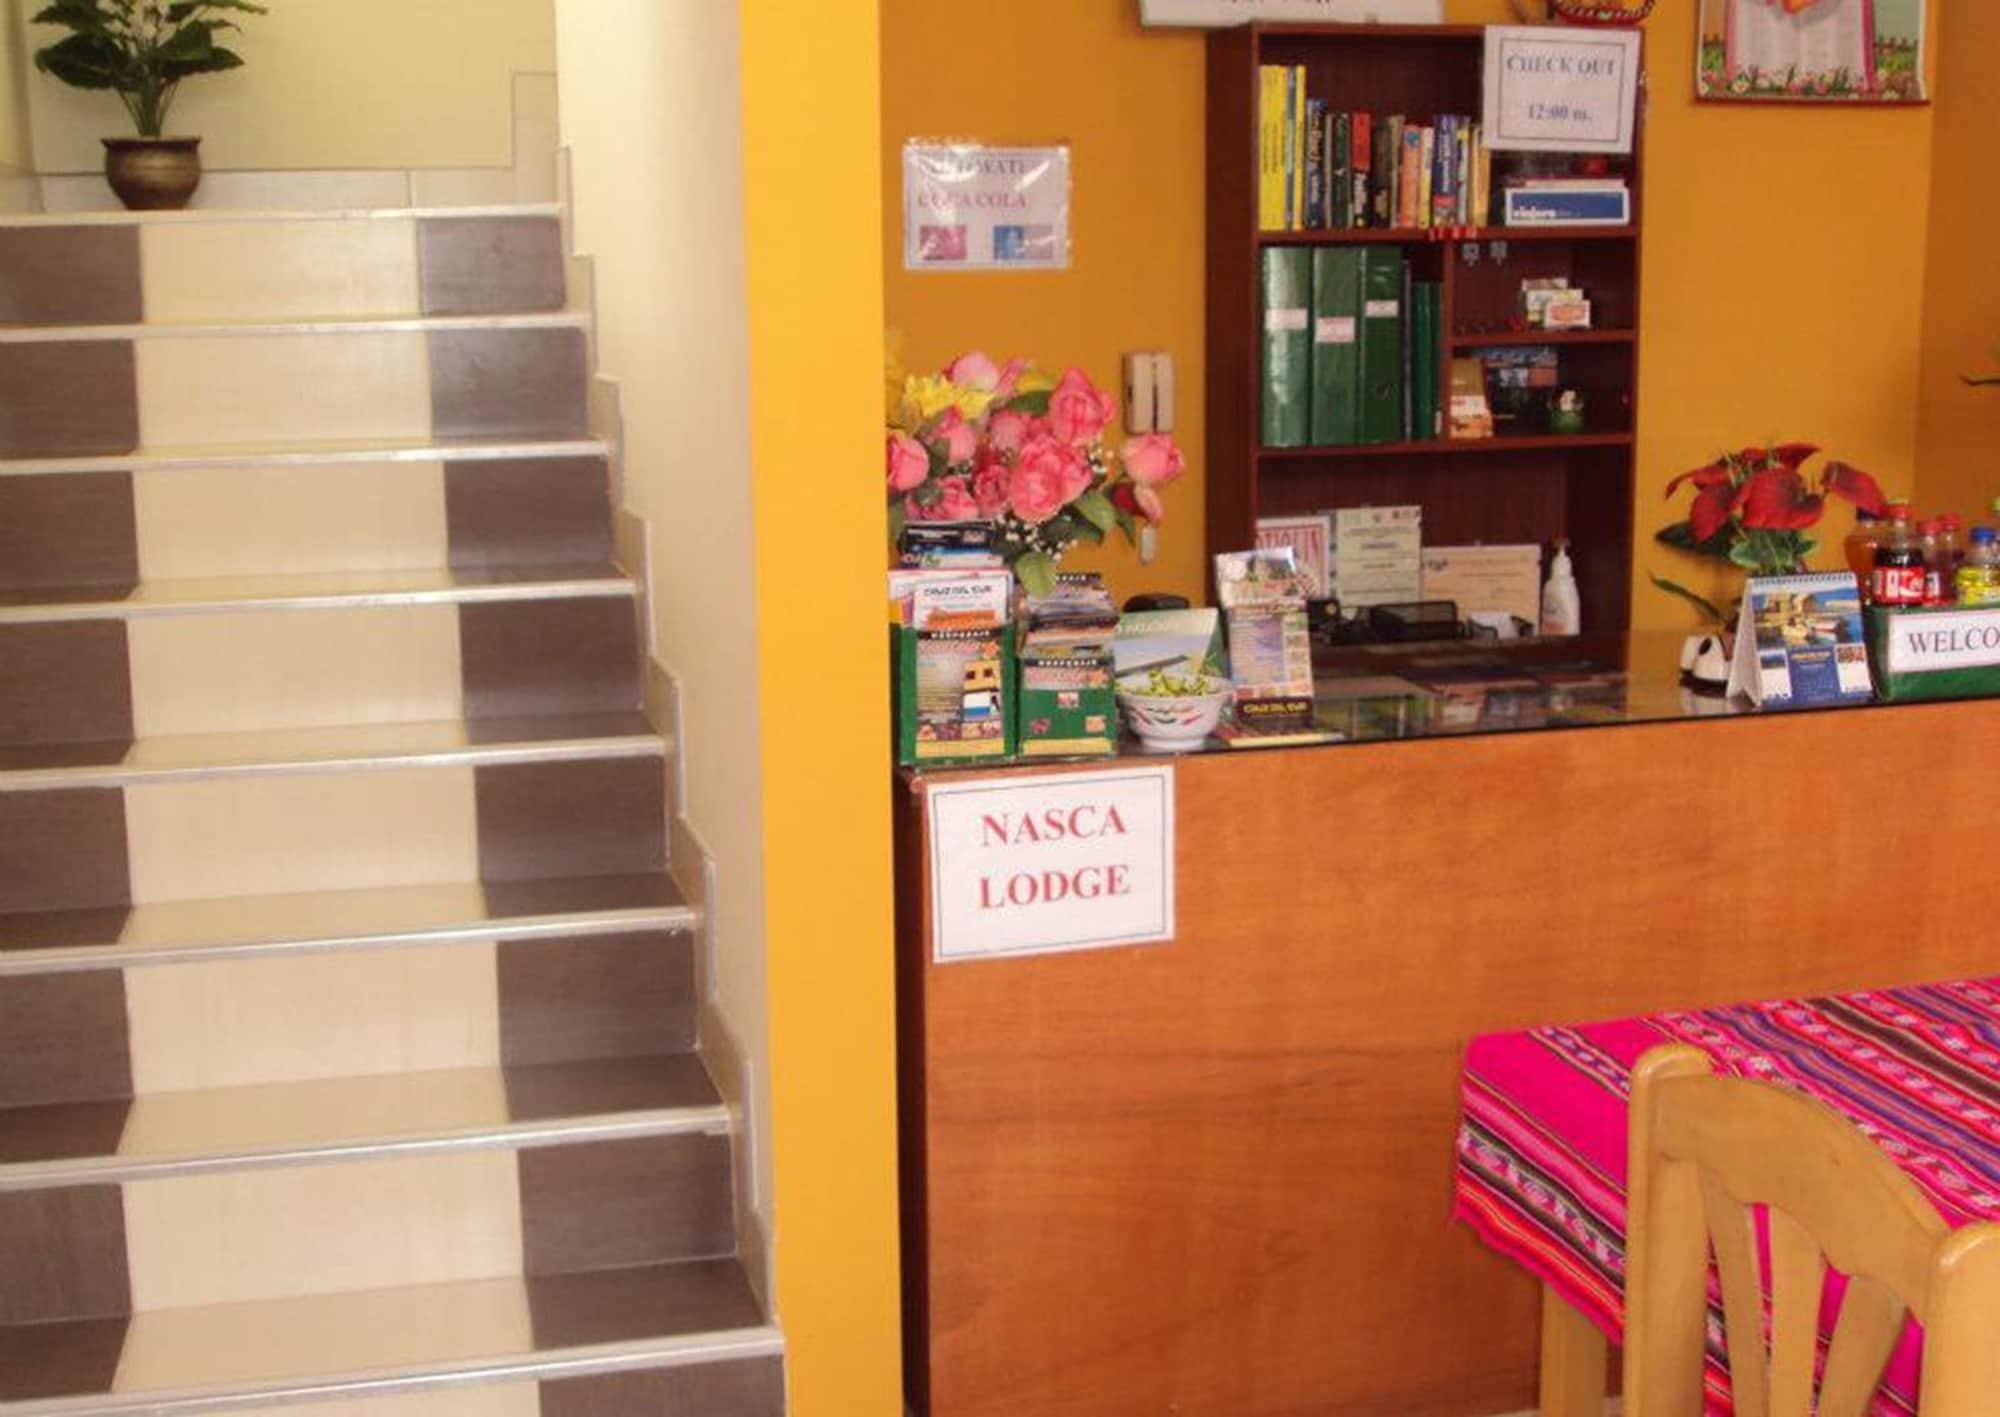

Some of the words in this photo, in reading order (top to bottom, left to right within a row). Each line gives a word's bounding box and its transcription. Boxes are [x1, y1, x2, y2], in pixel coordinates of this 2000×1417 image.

[1507, 55, 1573, 73] CHECK
[1577, 57, 1615, 76] OUT
[1528, 103, 1569, 120] 12:00
[975, 191, 1027, 209] COLA
[981, 804, 1127, 846] NASCA
[979, 863, 1130, 910] LODGE
